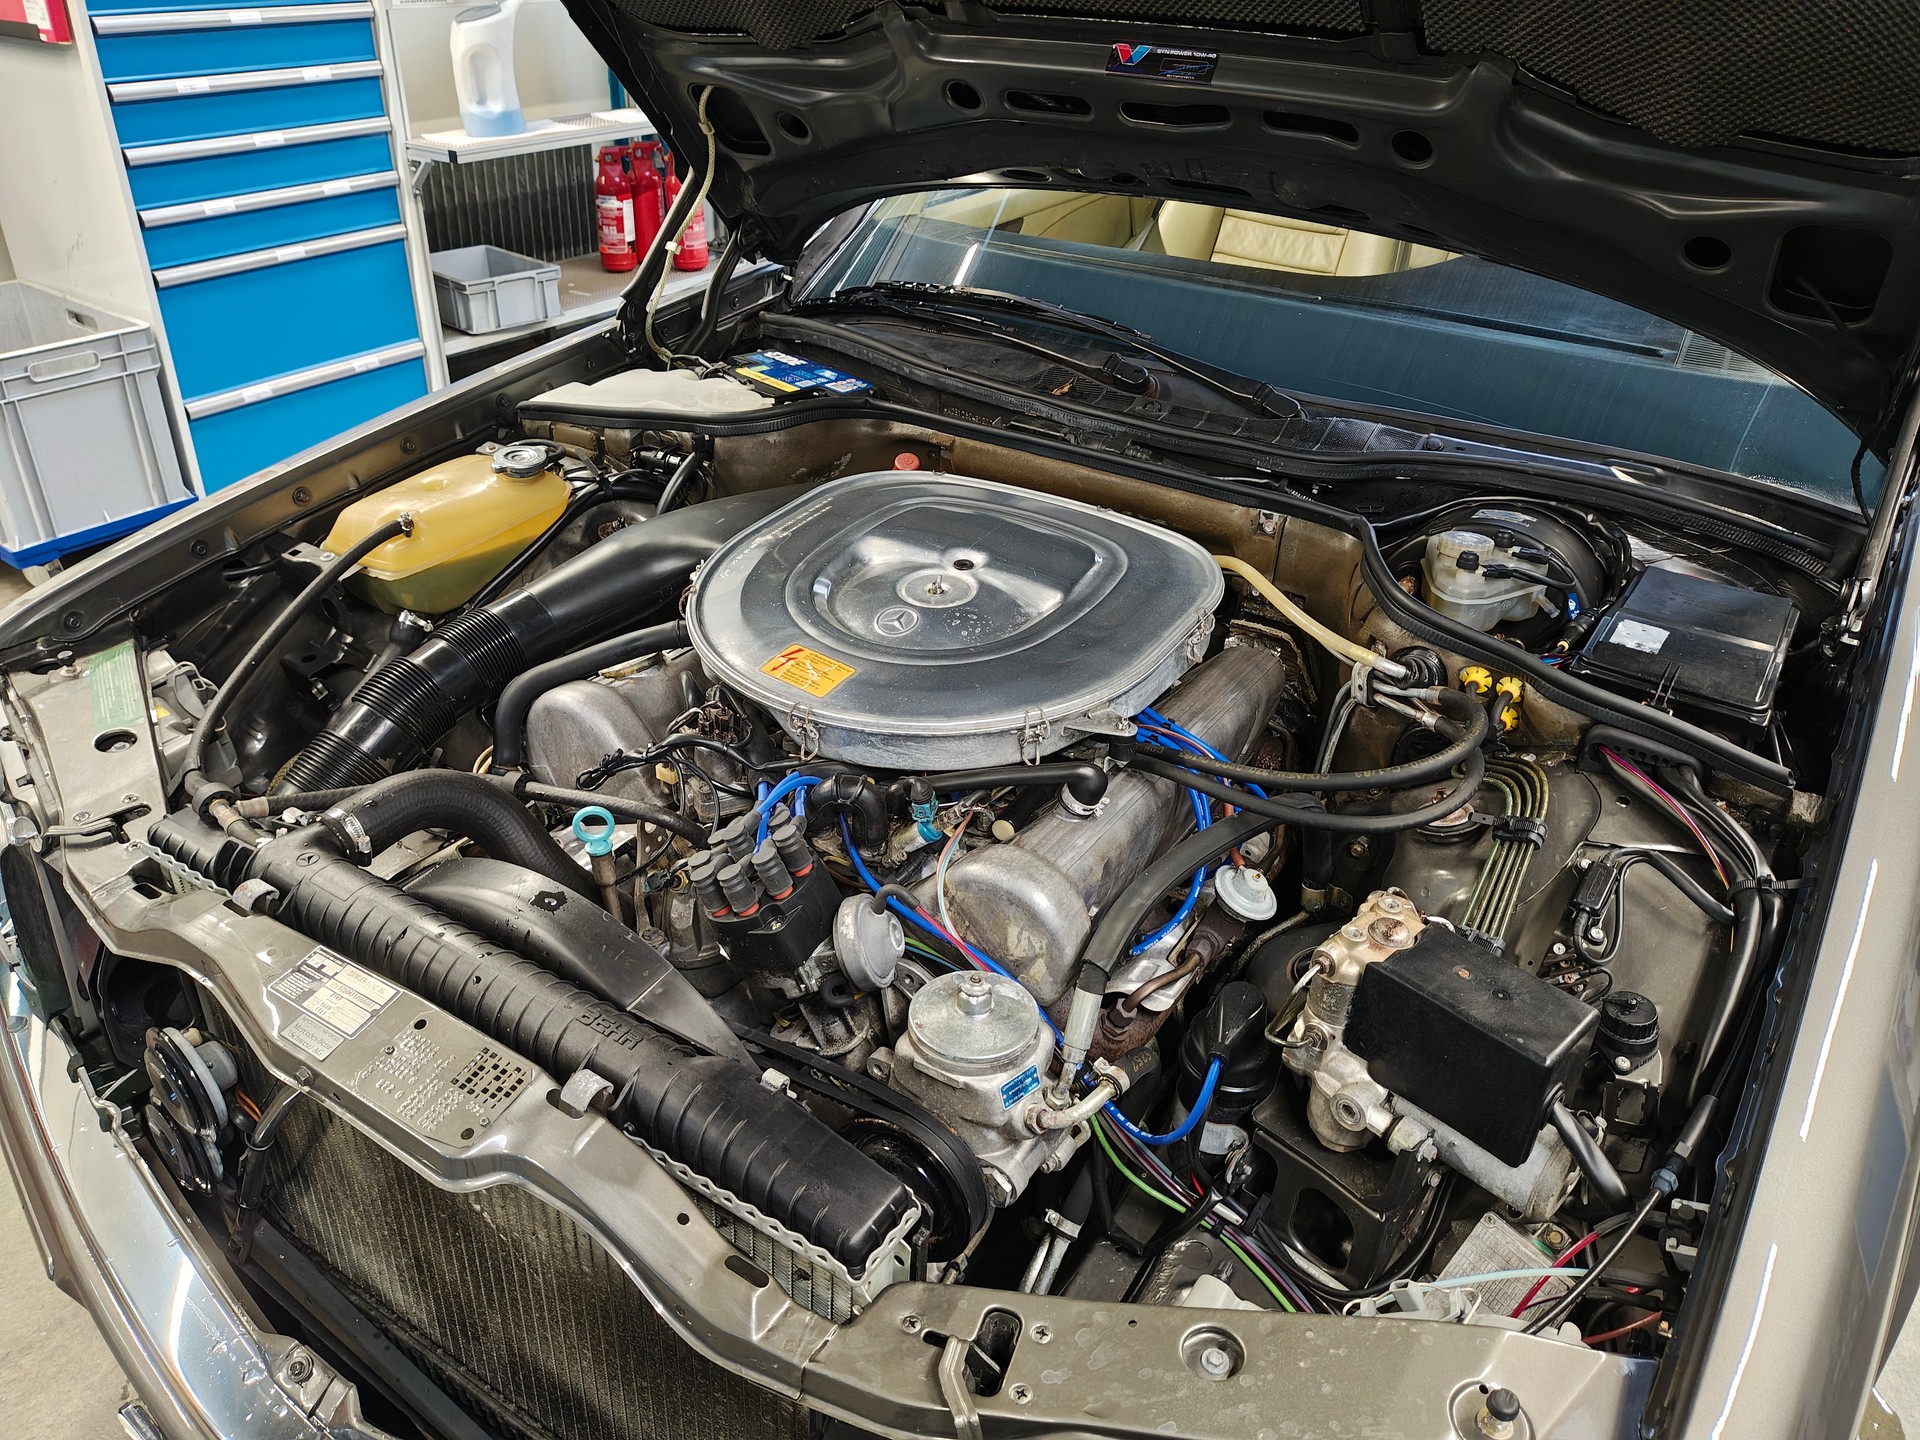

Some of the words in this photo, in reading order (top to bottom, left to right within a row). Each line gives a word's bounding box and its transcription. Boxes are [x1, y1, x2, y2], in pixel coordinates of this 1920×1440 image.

[1170, 49, 1192, 57] POWER
[1193, 51, 1217, 59] 10W-40
[294, 1022, 333, 1050] Mercedes-Benz
[575, 1006, 644, 1051] BEHR
